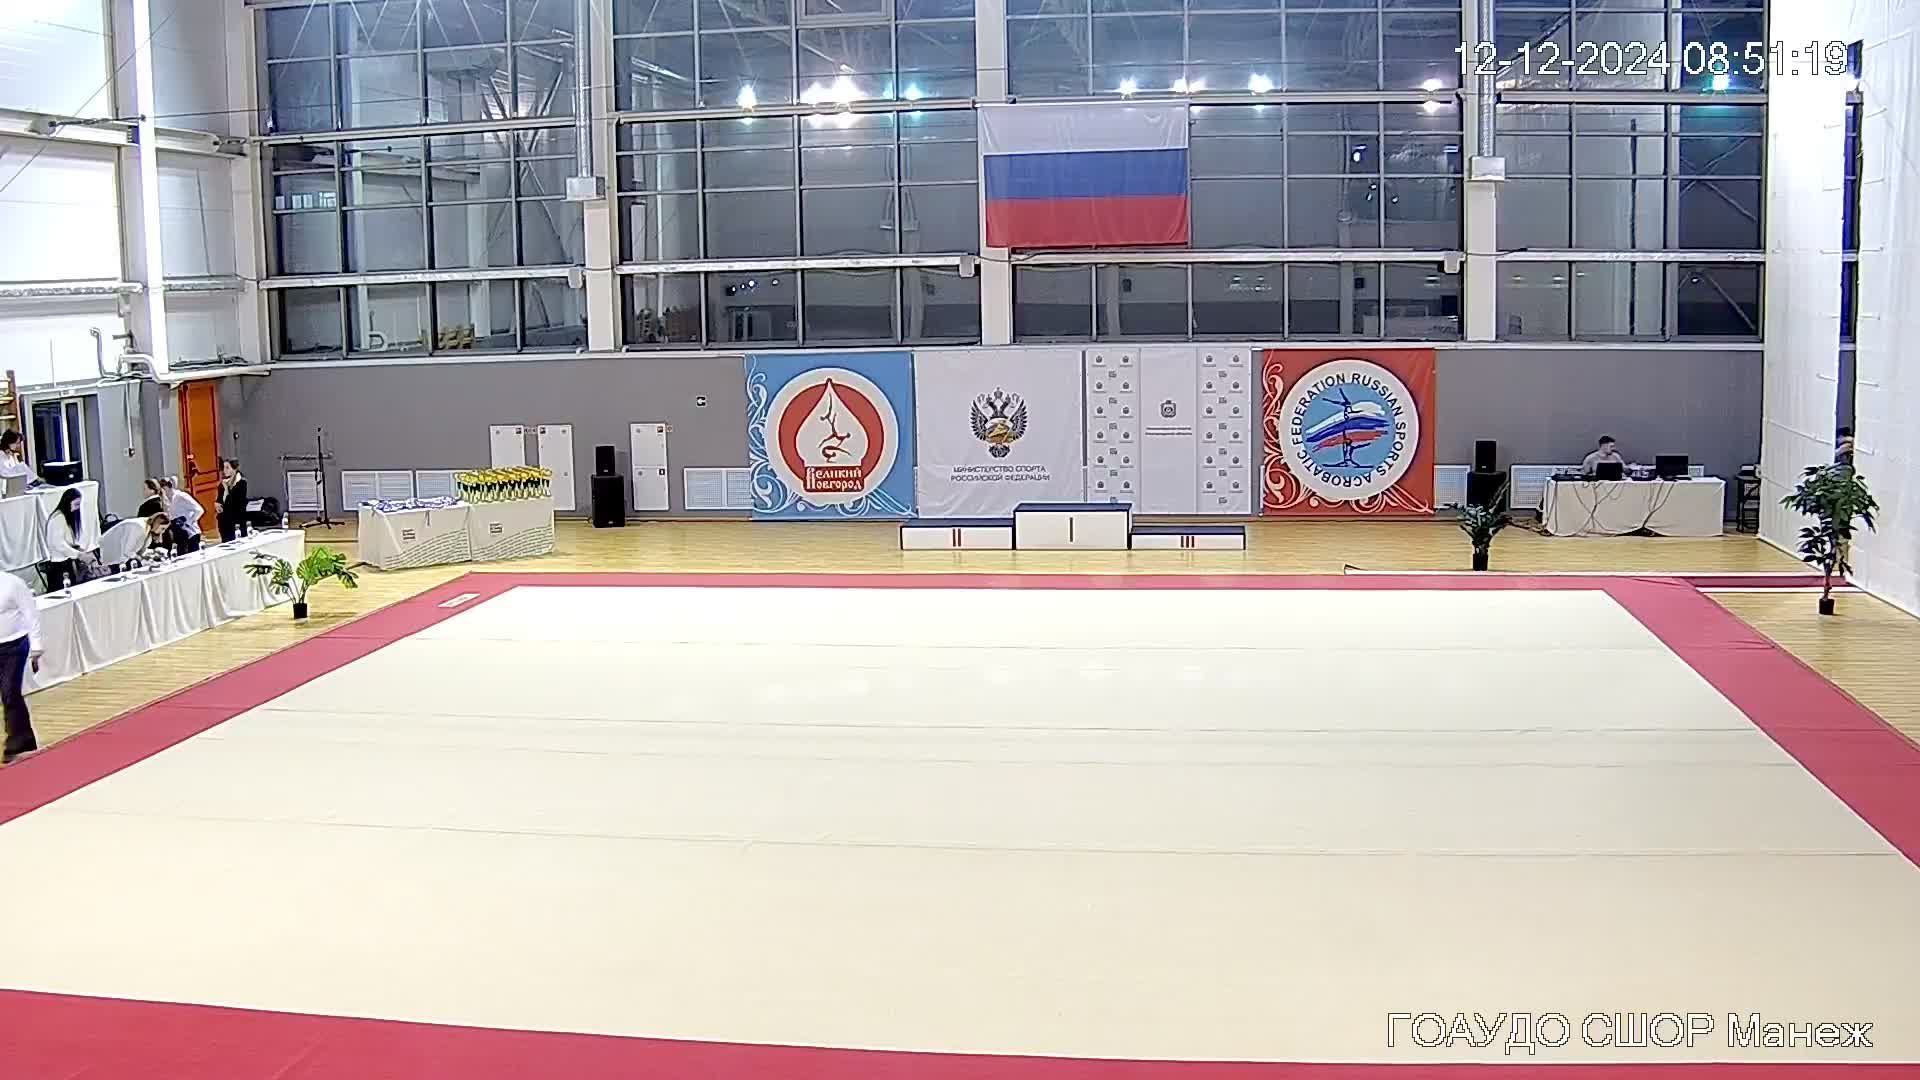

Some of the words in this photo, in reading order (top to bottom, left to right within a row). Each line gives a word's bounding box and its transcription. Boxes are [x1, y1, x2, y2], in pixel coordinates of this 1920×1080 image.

[1291, 373, 1345, 446] FEDERATION
[1351, 373, 1404, 417] RUSSIAN
[1296, 450, 1373, 488] ACROBATIC
[1376, 421, 1407, 477] SPORTS
